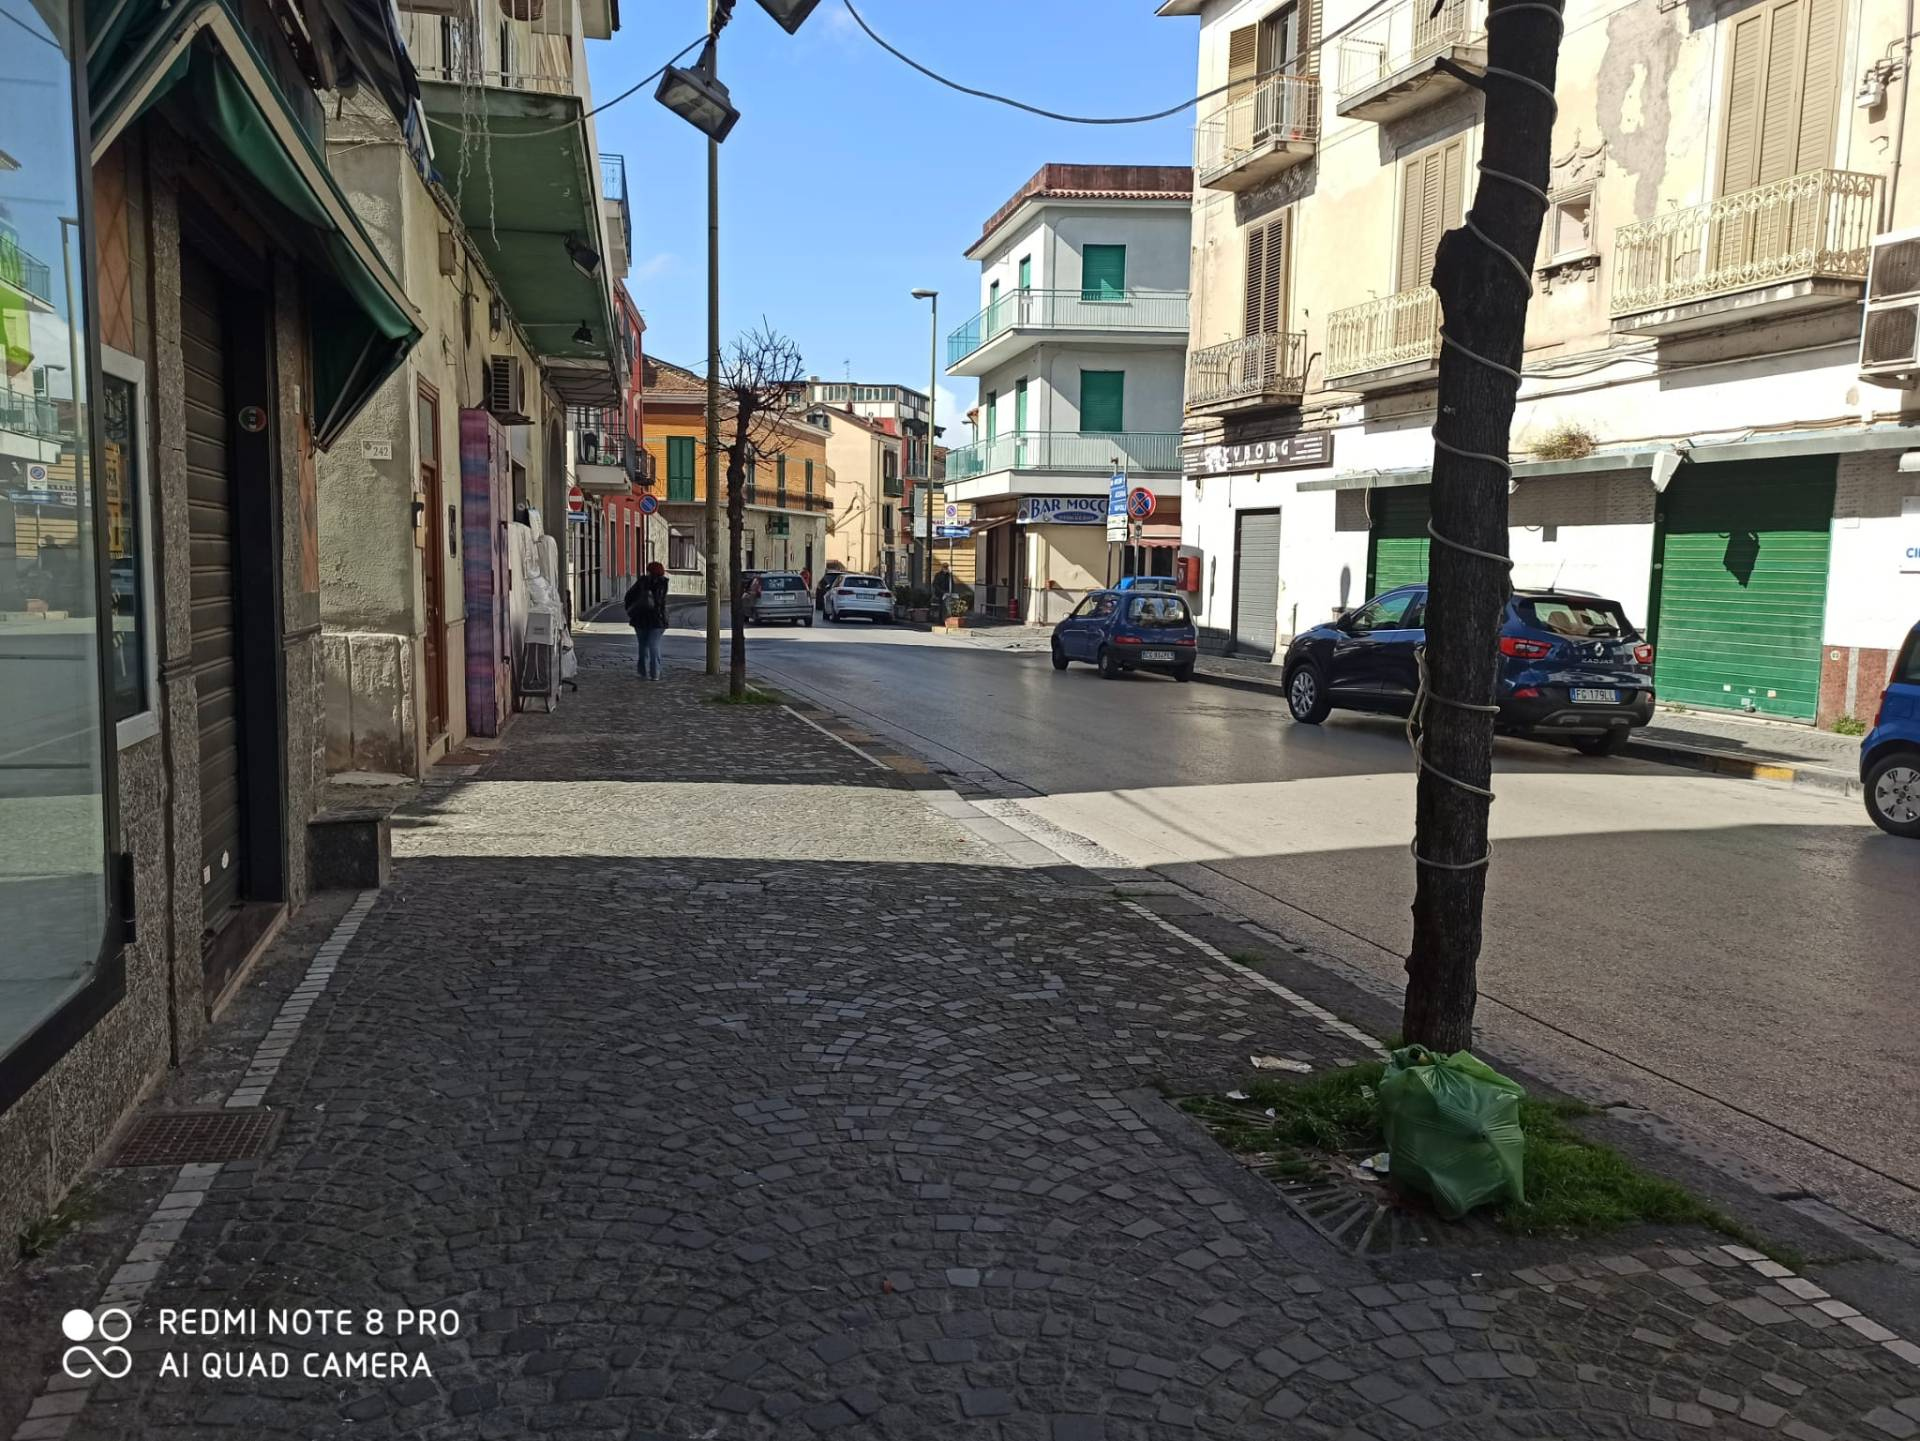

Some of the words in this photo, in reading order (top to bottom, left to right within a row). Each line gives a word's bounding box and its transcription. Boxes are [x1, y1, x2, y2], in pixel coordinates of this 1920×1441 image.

[373, 446, 389, 457] 242
[1031, 498, 1061, 519] BAR
[1906, 547, 1920, 558] CI
